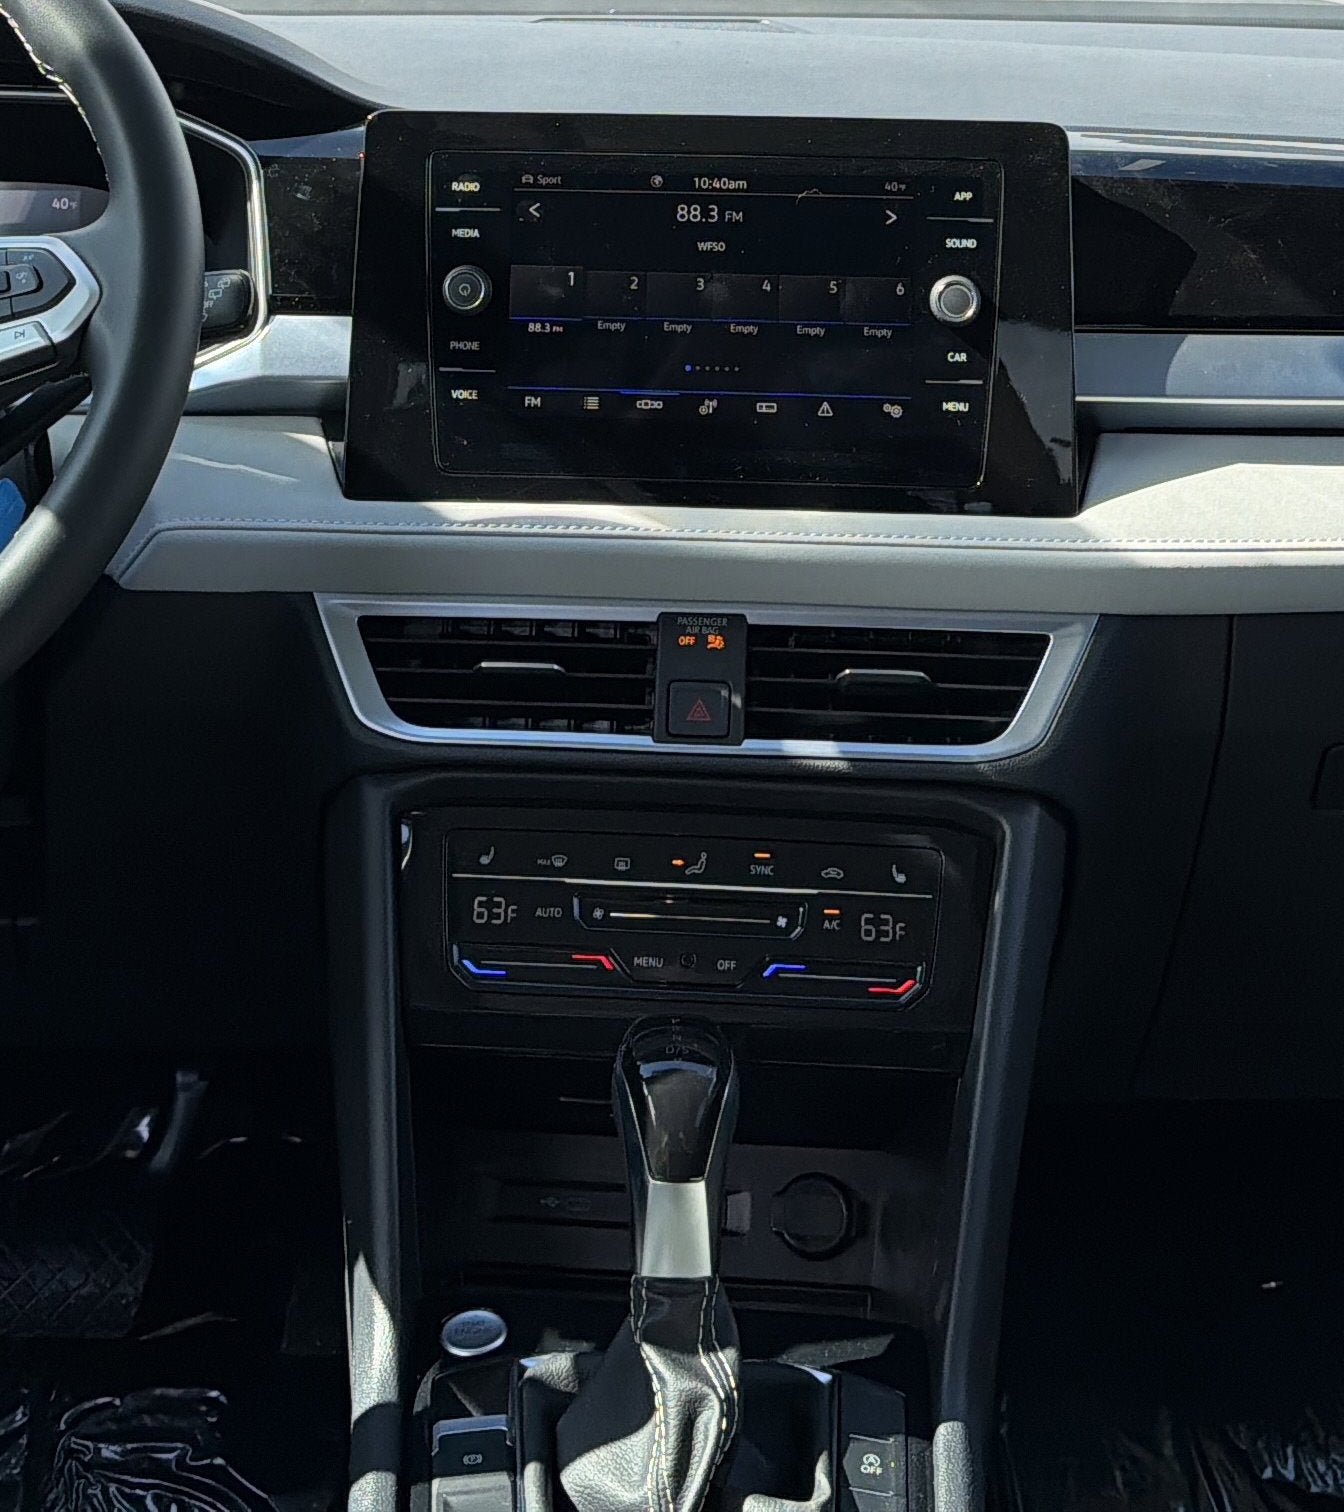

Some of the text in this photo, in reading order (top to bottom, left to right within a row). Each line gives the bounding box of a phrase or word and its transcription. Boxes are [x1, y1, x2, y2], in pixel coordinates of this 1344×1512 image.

[537, 175, 561, 185] Sport
[693, 177, 747, 189] 10:40am
[452, 182, 480, 192] RADIO
[954, 192, 973, 201] APP
[676, 204, 743, 222] 88.3 FM
[452, 229, 480, 238] MEDIA
[945, 239, 977, 248] SOUND
[567, 271, 575, 286] 1
[629, 276, 639, 289] 2
[696, 278, 704, 290] 3
[762, 280, 771, 292] 4
[829, 281, 838, 294] 5
[896, 282, 904, 295] 6
[528, 322, 551, 333] 88.3
[597, 320, 626, 331] Empty
[663, 321, 692, 333] Empty
[730, 323, 758, 335] Empty
[796, 325, 825, 336] Empty
[863, 327, 892, 338] Empty
[450, 341, 480, 351] PHONE
[947, 352, 967, 362] CAR
[451, 389, 478, 400] VOICE
[524, 396, 541, 407] FM
[942, 402, 969, 412] MENU
[677, 616, 728, 626] PASSENGER
[686, 626, 719, 634] AIR BAG
[678, 635, 696, 645] OFF
[750, 865, 774, 876] SYNC
[535, 907, 562, 918] AUTO
[823, 919, 841, 930] A/C
[634, 956, 663, 968] MENU
[717, 959, 736, 970] OFF
[860, 1464, 882, 1475] OFF
